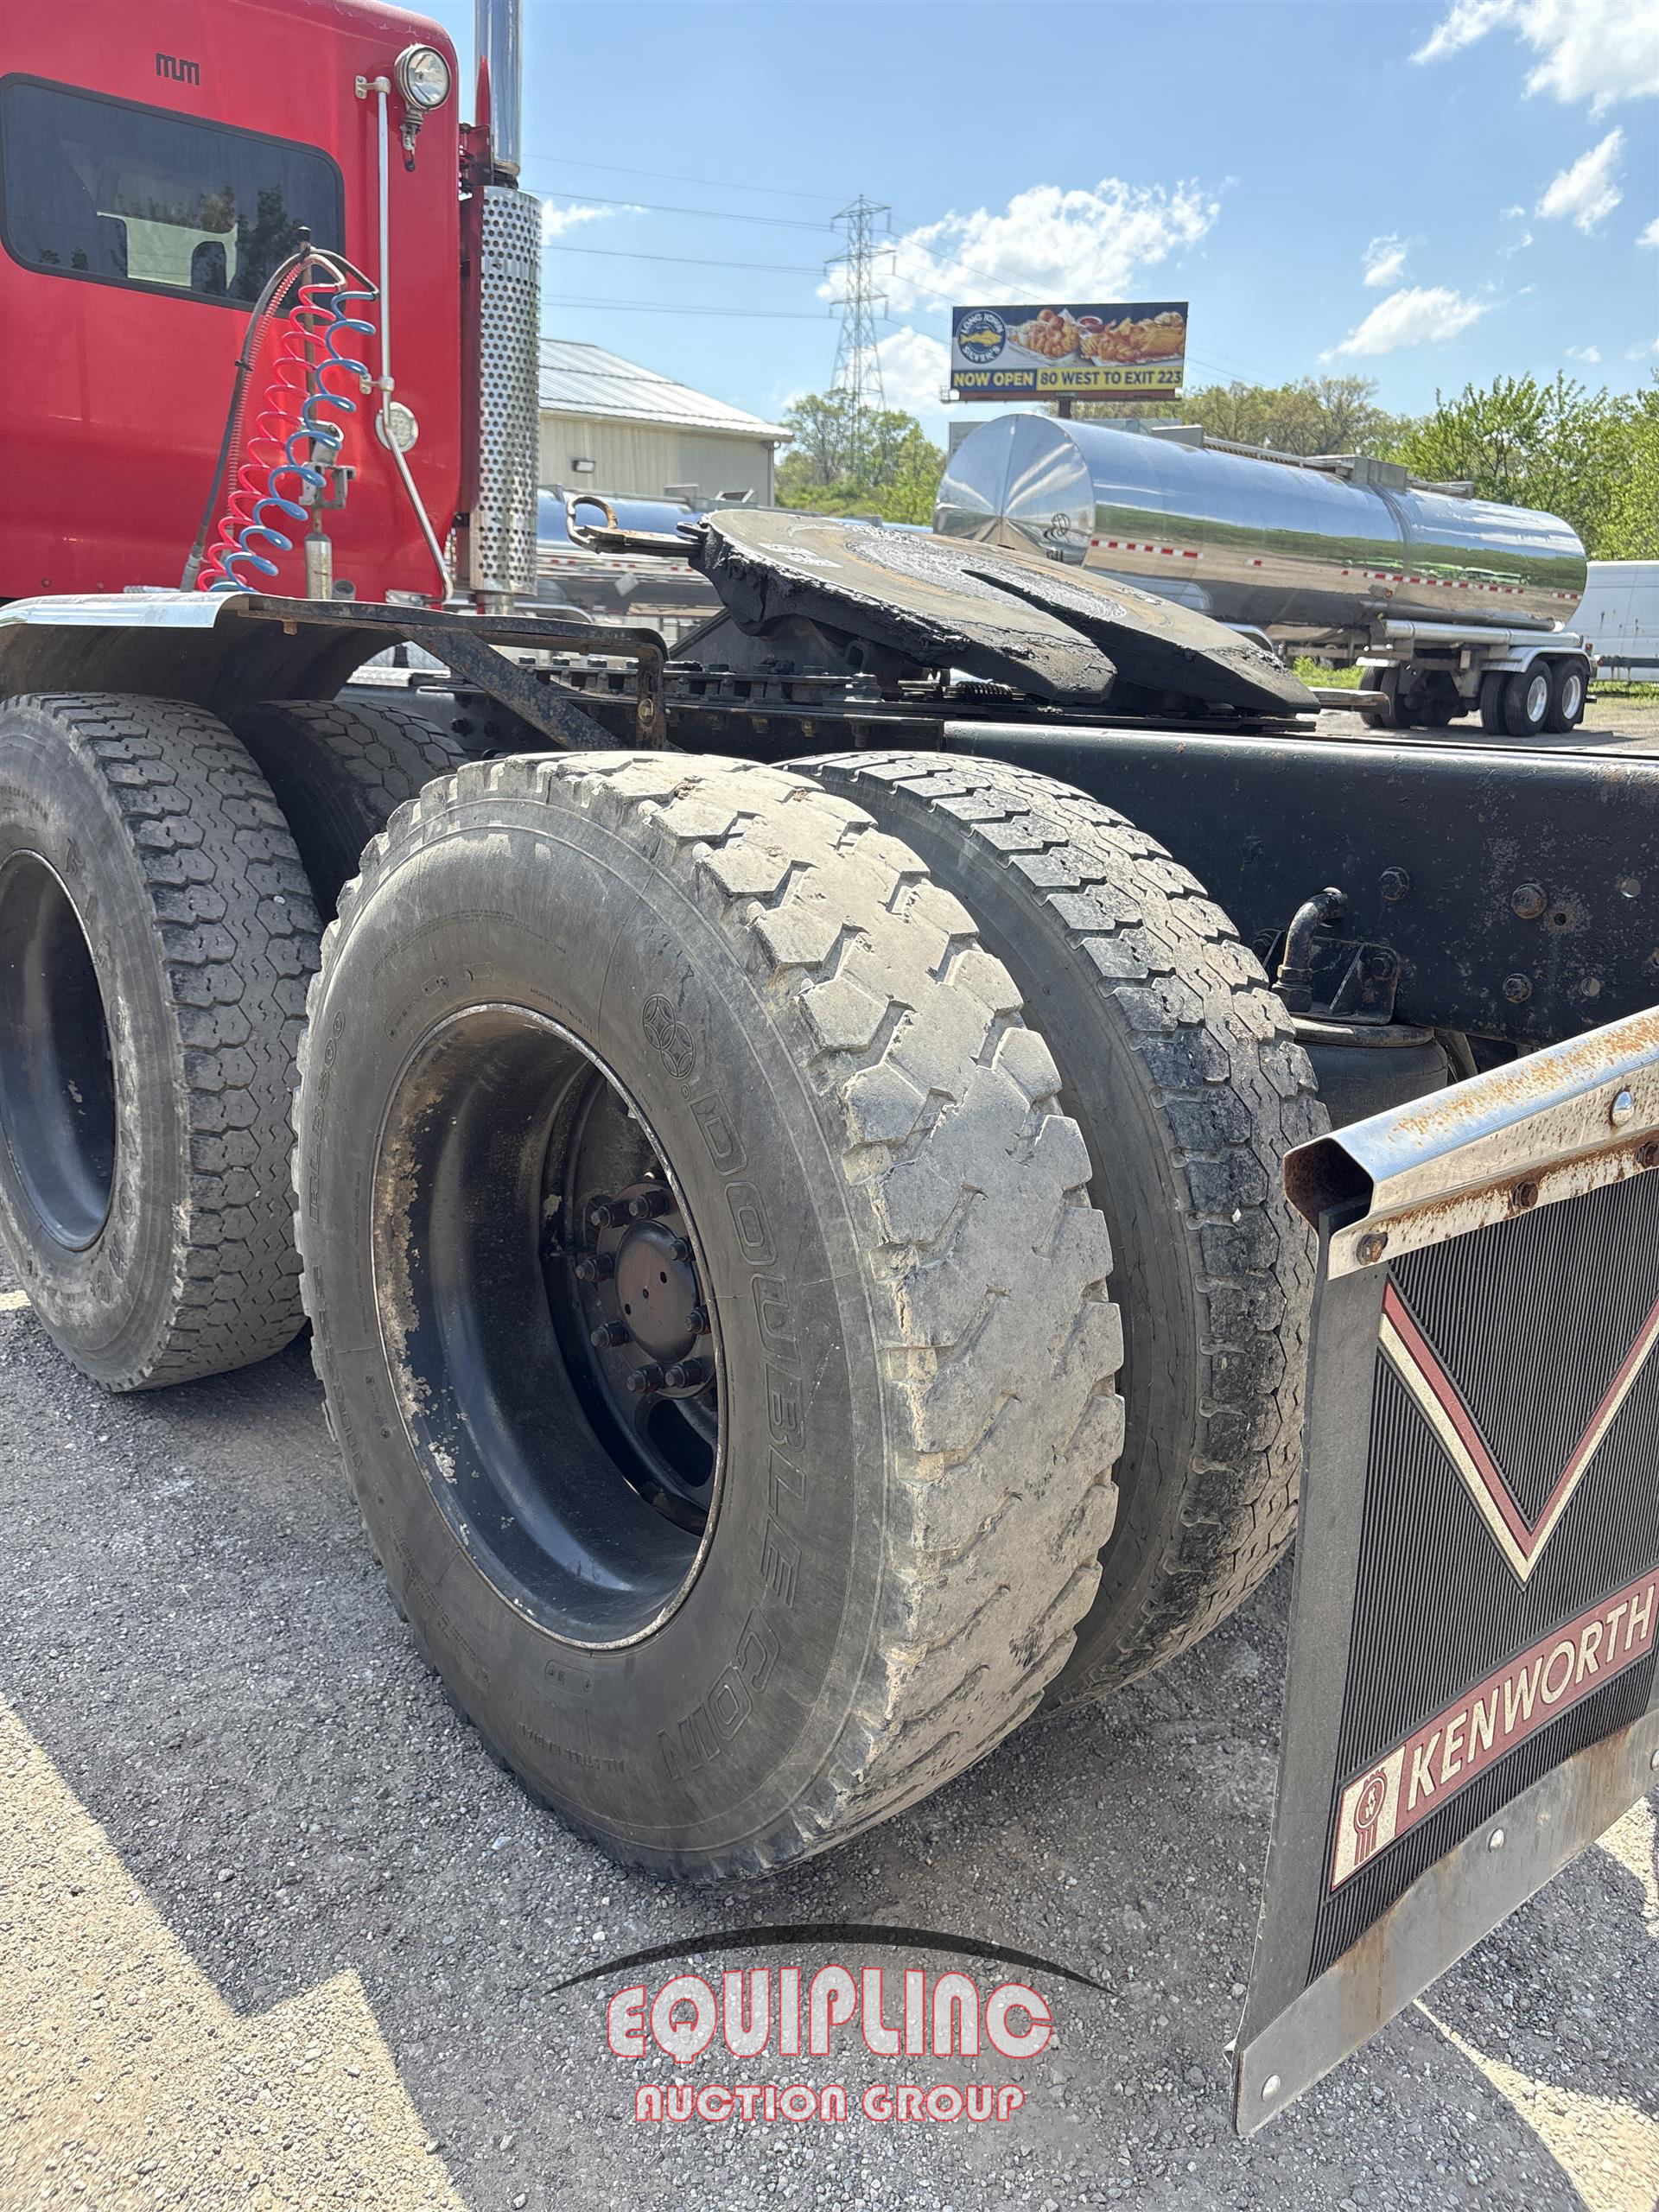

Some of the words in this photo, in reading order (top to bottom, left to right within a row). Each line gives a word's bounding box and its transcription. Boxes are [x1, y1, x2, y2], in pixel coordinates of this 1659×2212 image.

[960, 313, 983, 334] LONG
[953, 371, 990, 387] NOW
[993, 372, 1035, 387] OPEN
[1039, 372, 1058, 385] 80
[1062, 372, 1100, 385] WEST
[1104, 372, 1121, 385] TO
[1124, 371, 1154, 385] EXIT
[1157, 370, 1181, 385] 223
[690, 1089, 807, 1612] DOUBLE
[658, 1608, 781, 1782] COIN
[1407, 1583, 1657, 1812] KENWORTH
